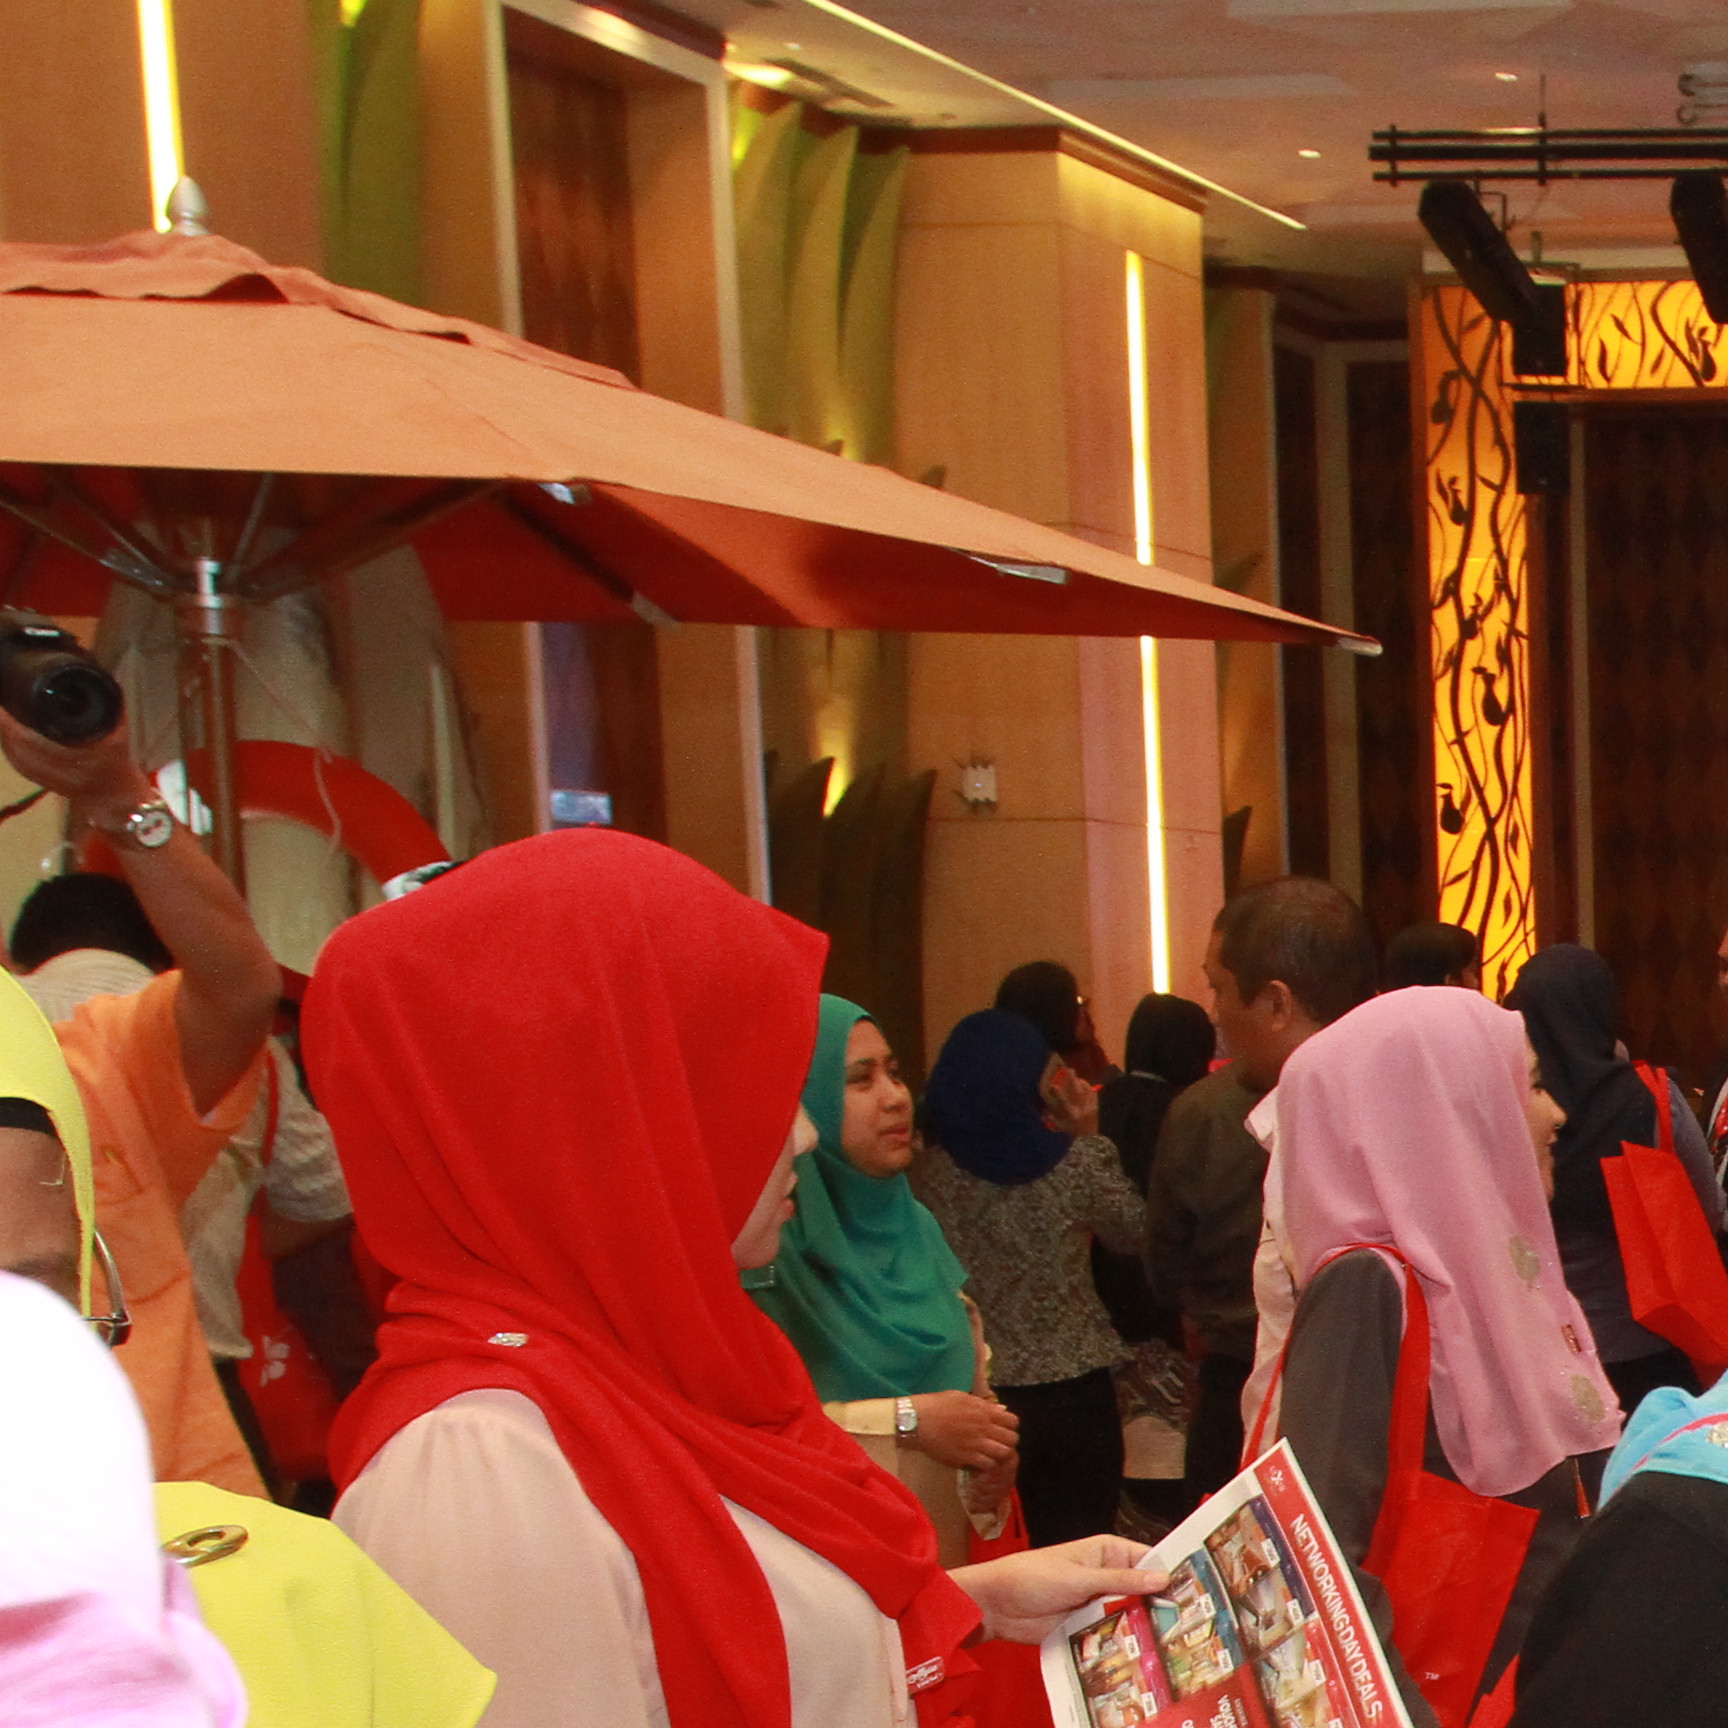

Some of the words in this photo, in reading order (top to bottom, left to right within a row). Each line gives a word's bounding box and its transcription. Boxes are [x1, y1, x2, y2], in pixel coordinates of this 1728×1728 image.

[1288, 1513, 1351, 1632] NETWORKING
[1336, 1626, 1362, 1665] DAY
[1347, 1658, 1385, 1720] DEALS
